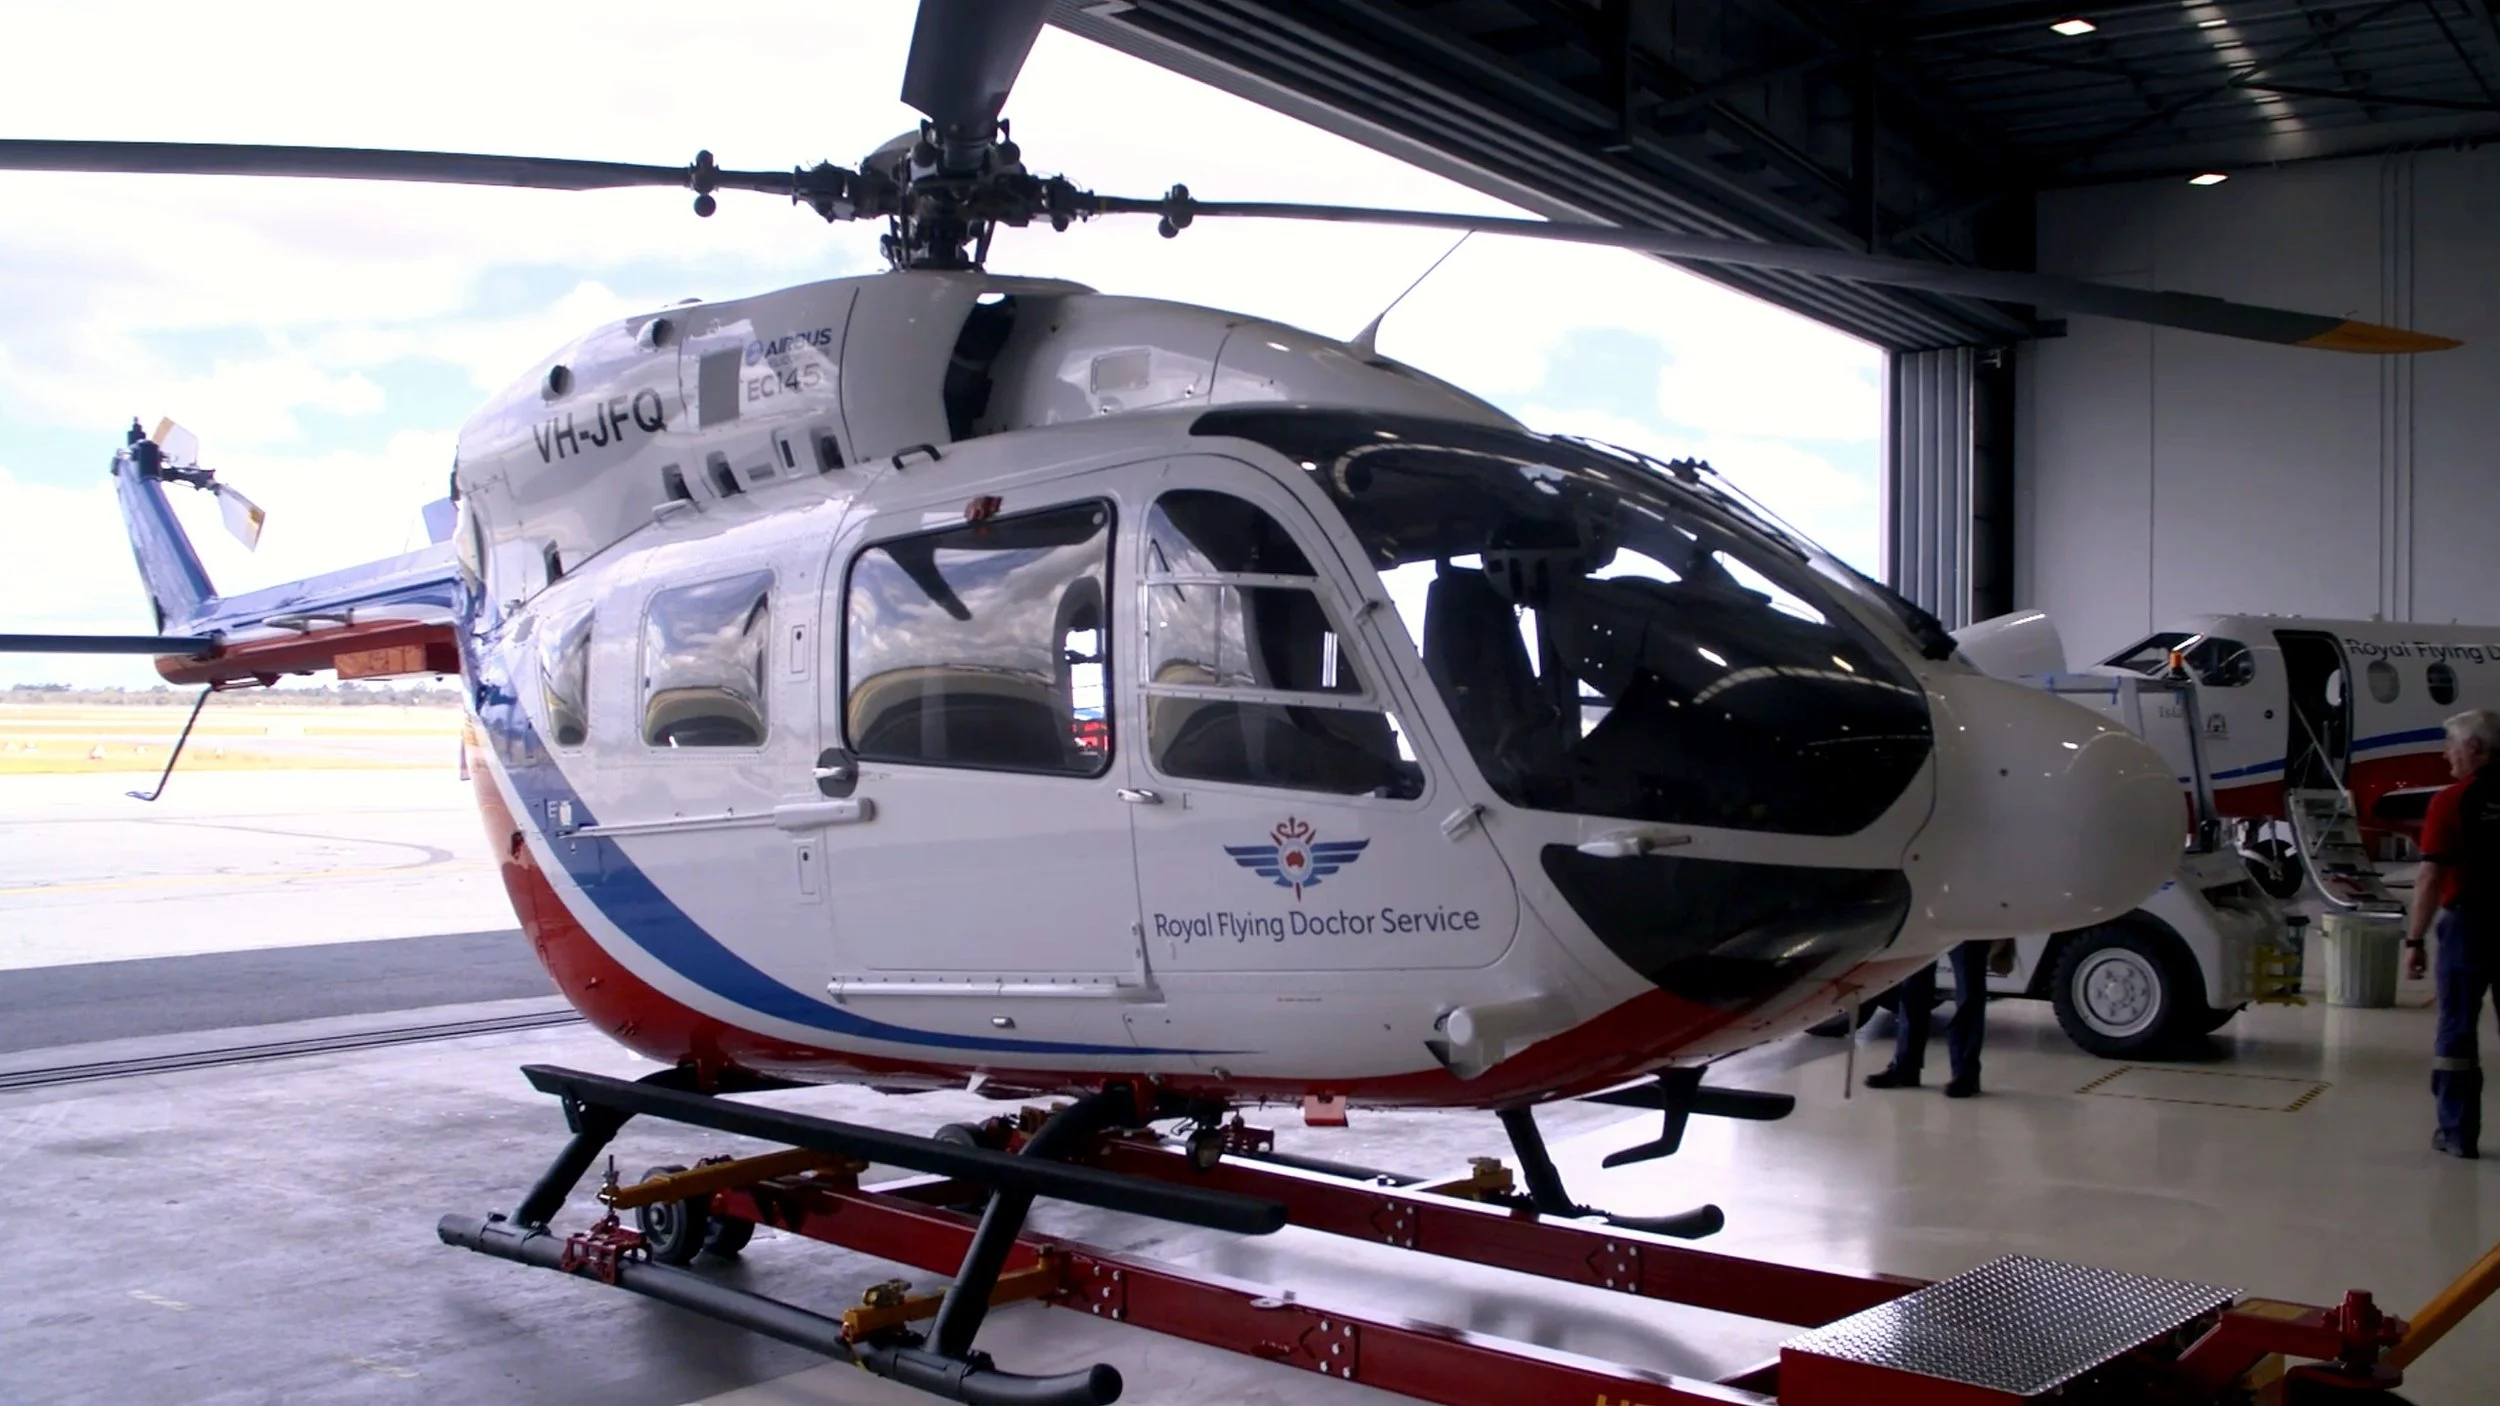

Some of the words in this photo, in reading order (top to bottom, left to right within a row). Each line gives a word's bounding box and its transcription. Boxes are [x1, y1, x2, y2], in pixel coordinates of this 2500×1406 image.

[747, 362, 822, 402] EC145
[532, 387, 668, 464] VH-JFQ
[2344, 638, 2411, 661] Royal
[2412, 641, 2485, 664] Flying
[1154, 912, 1213, 943] Royal
[1216, 911, 1285, 943] Flying
[1288, 909, 1375, 936] Doctor
[1380, 904, 1481, 934] Service
